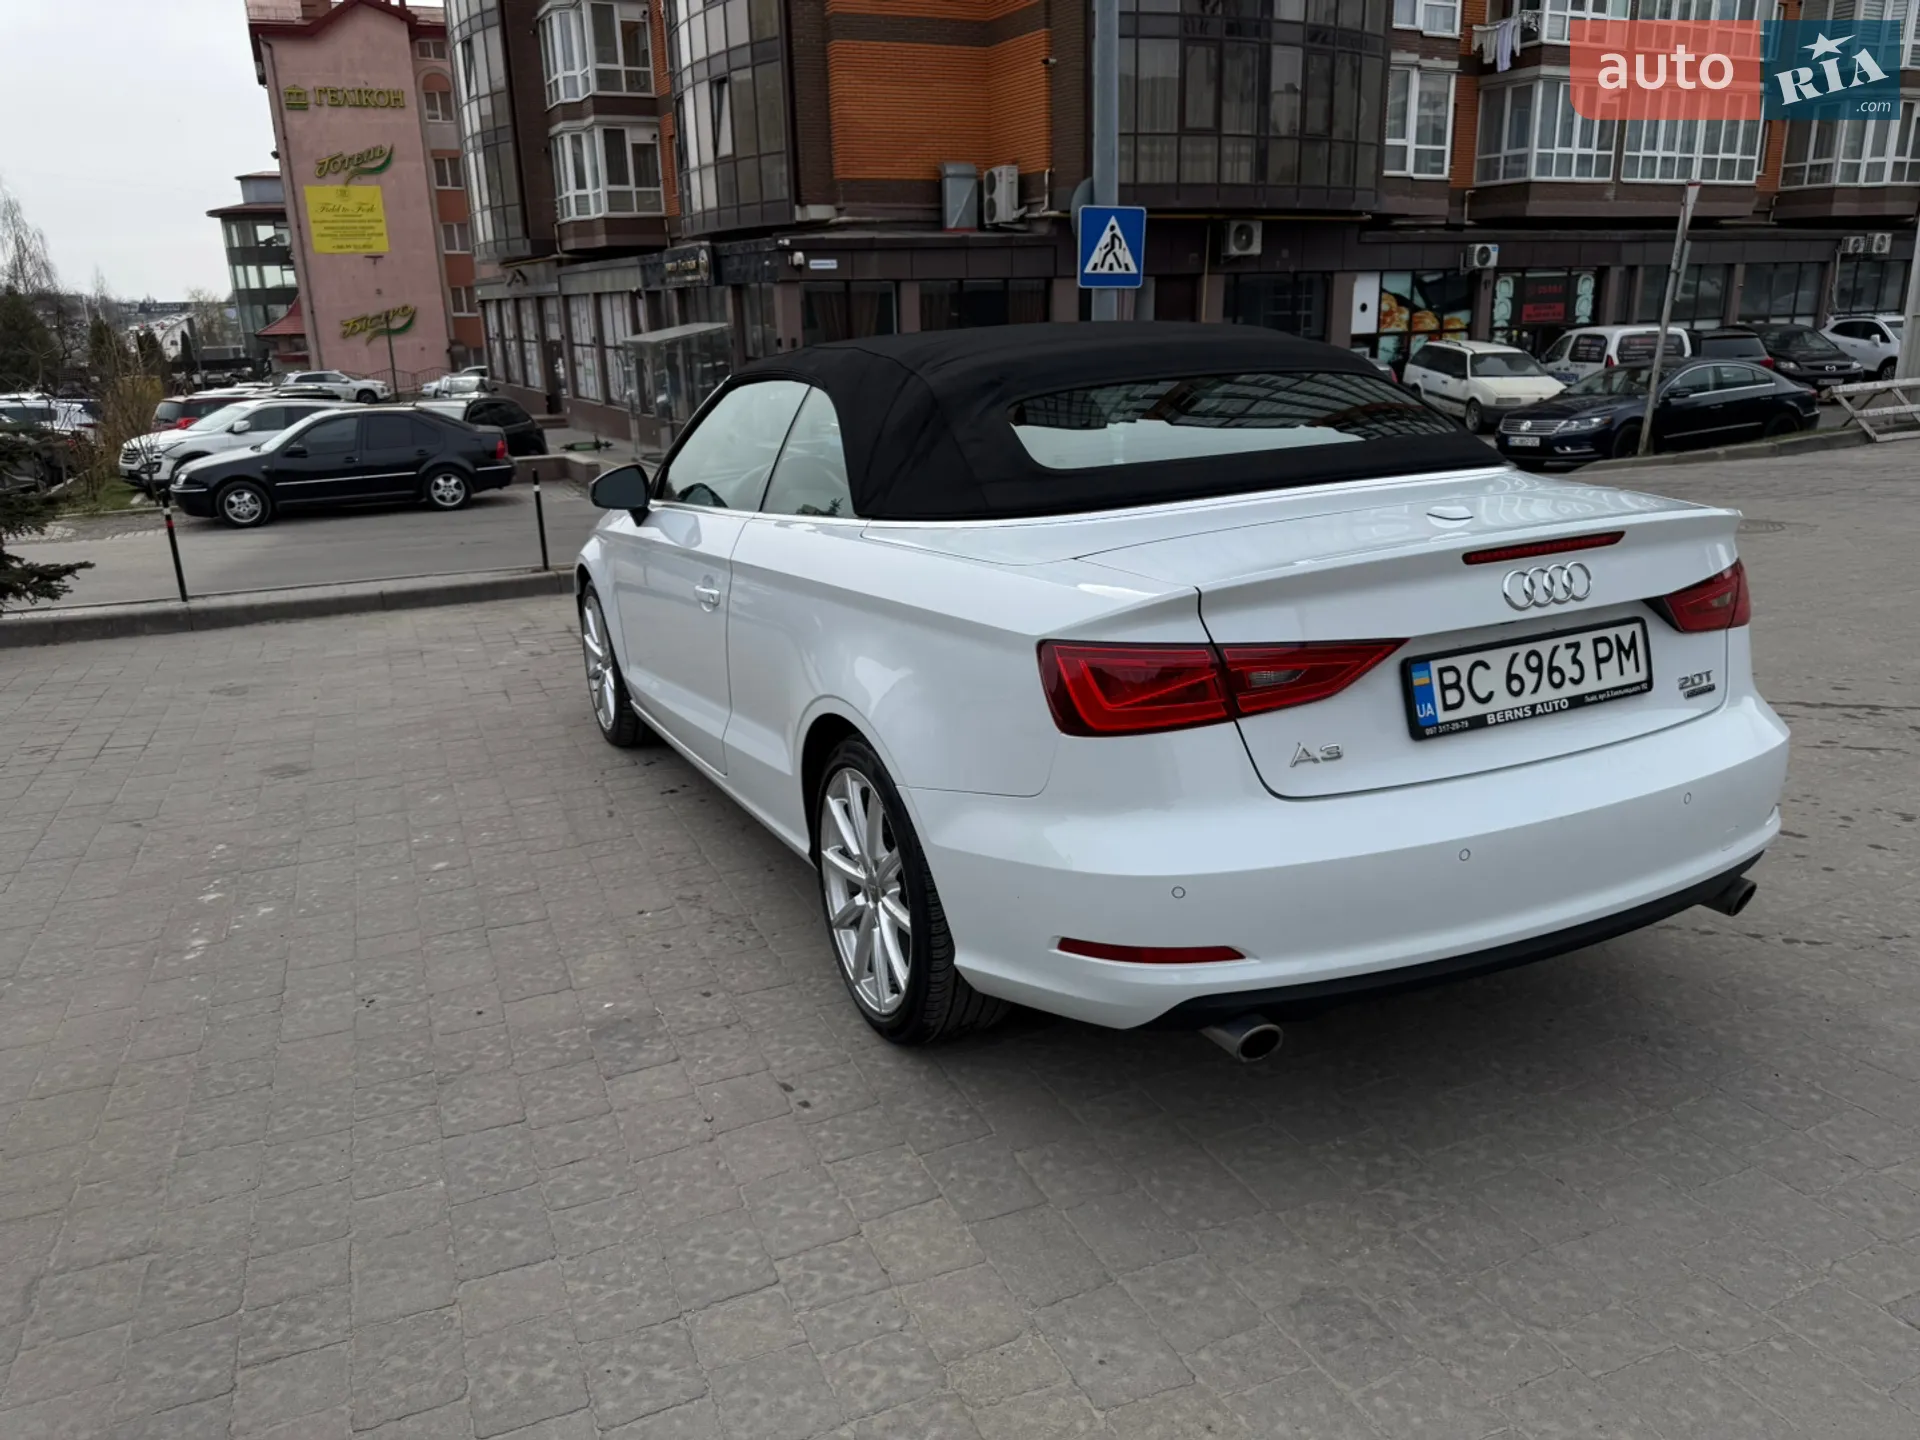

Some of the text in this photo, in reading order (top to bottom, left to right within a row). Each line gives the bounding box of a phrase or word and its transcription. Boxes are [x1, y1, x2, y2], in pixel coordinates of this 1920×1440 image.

[314, 86, 405, 108] ГЕЛІКОН
[1437, 630, 1640, 712] BC 6963 PM
[1416, 703, 1435, 720] UA
[1486, 698, 1570, 726] BERNS AUTO
